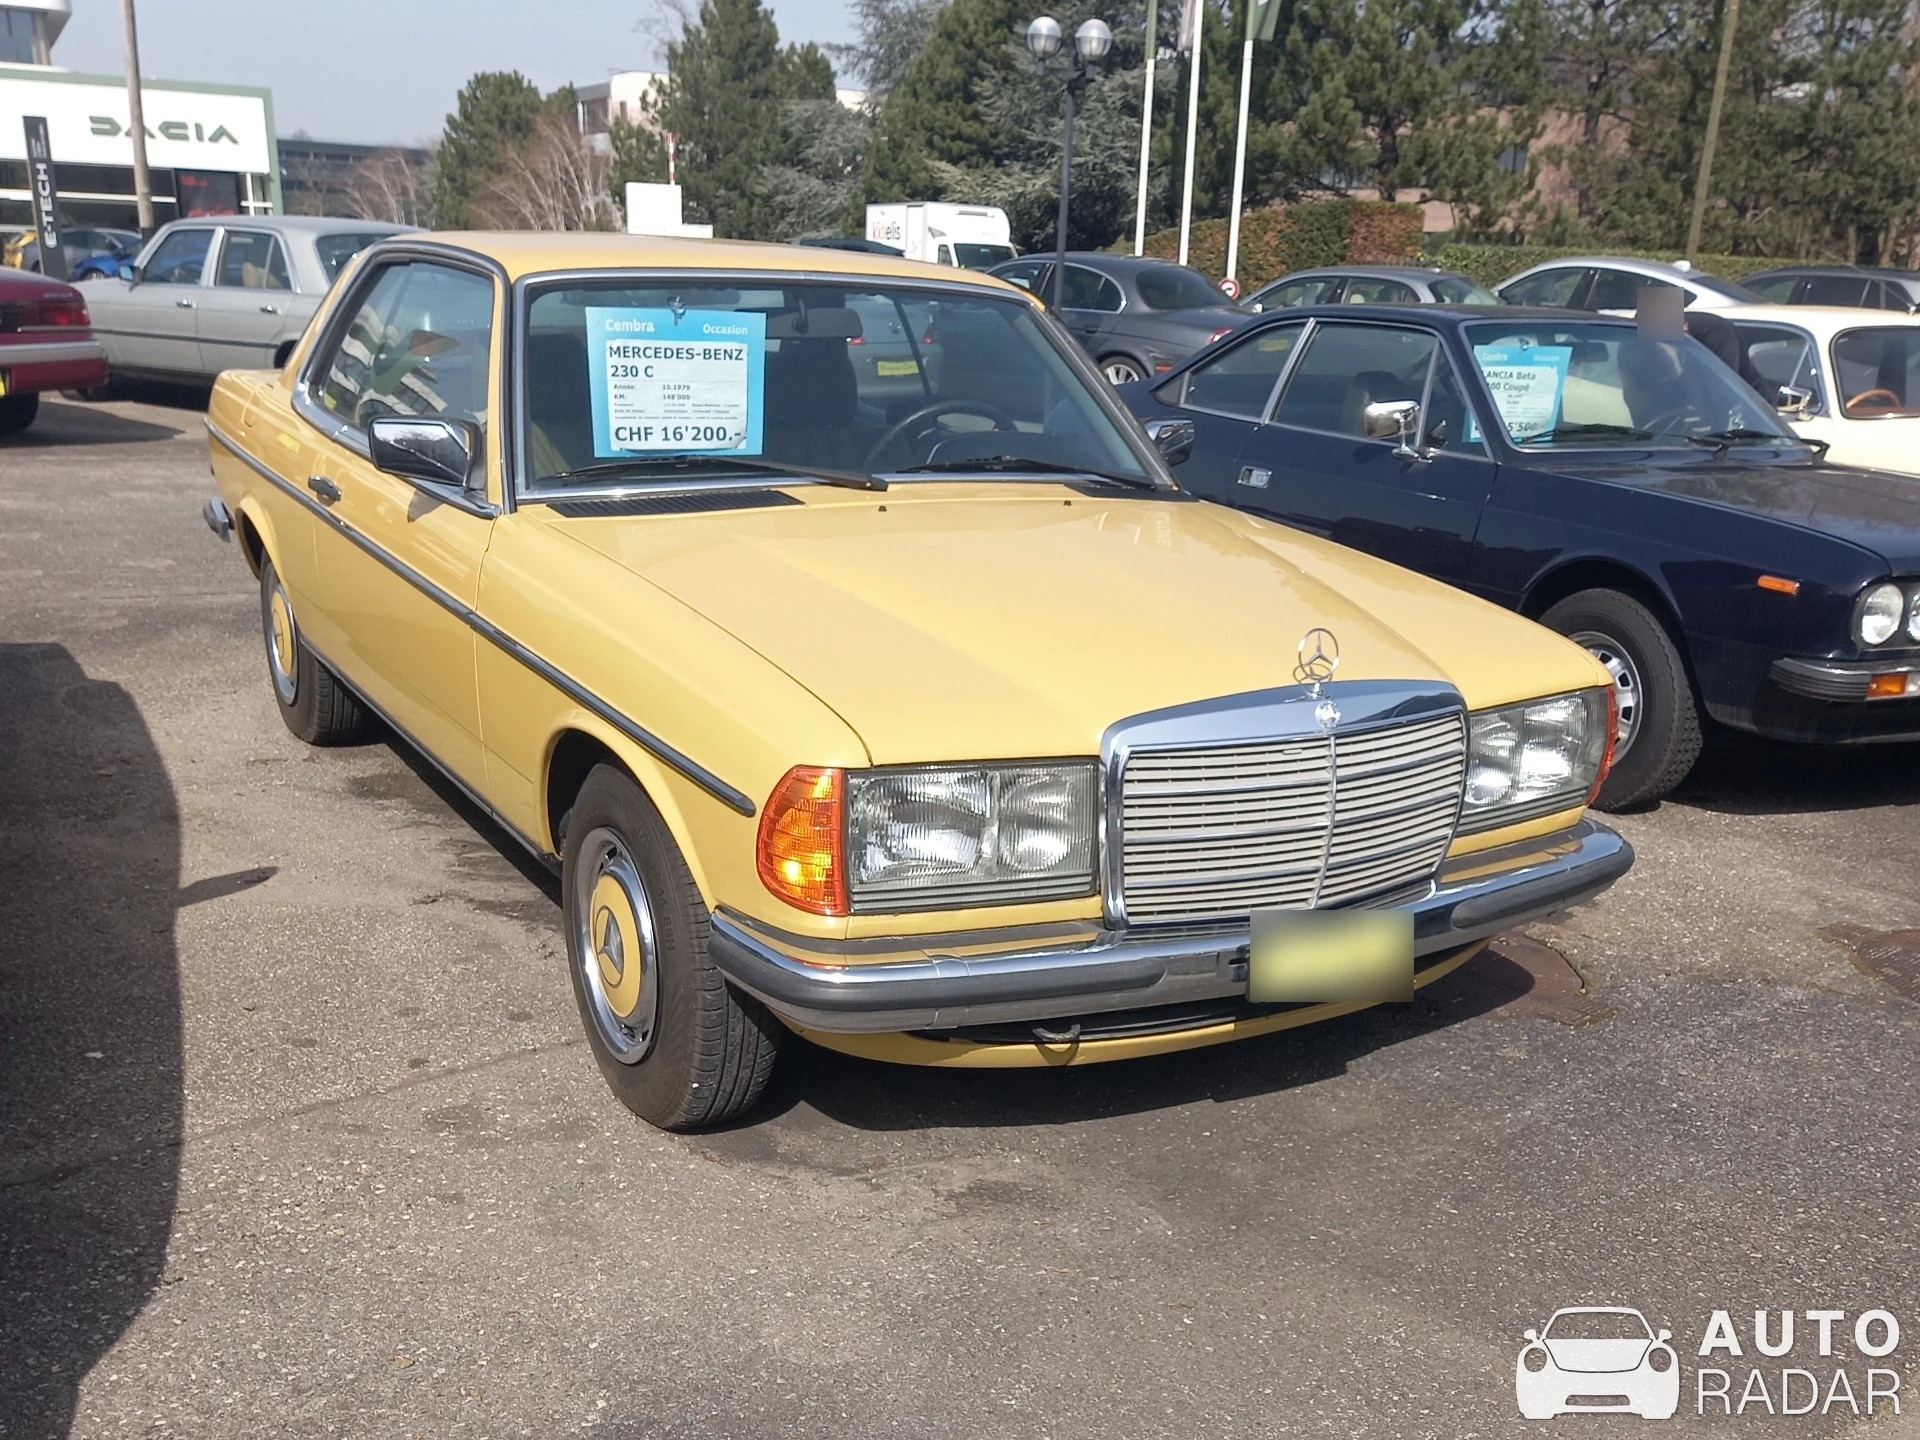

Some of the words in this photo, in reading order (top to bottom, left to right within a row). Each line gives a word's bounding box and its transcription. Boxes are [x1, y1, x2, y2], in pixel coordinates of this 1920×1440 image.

[36, 163, 58, 249] E-TECH
[605, 318, 655, 333] Cembra
[702, 323, 748, 335] Occasion
[609, 346, 744, 361] MERCEDES-BENZ
[610, 365, 639, 377] 230
[644, 365, 654, 378] C
[1481, 370, 1513, 379] ANCIA
[1516, 371, 1536, 380] Beta
[1503, 382, 1530, 393] Coupé
[614, 427, 654, 441] CHF
[661, 426, 742, 441] 16'200.-
